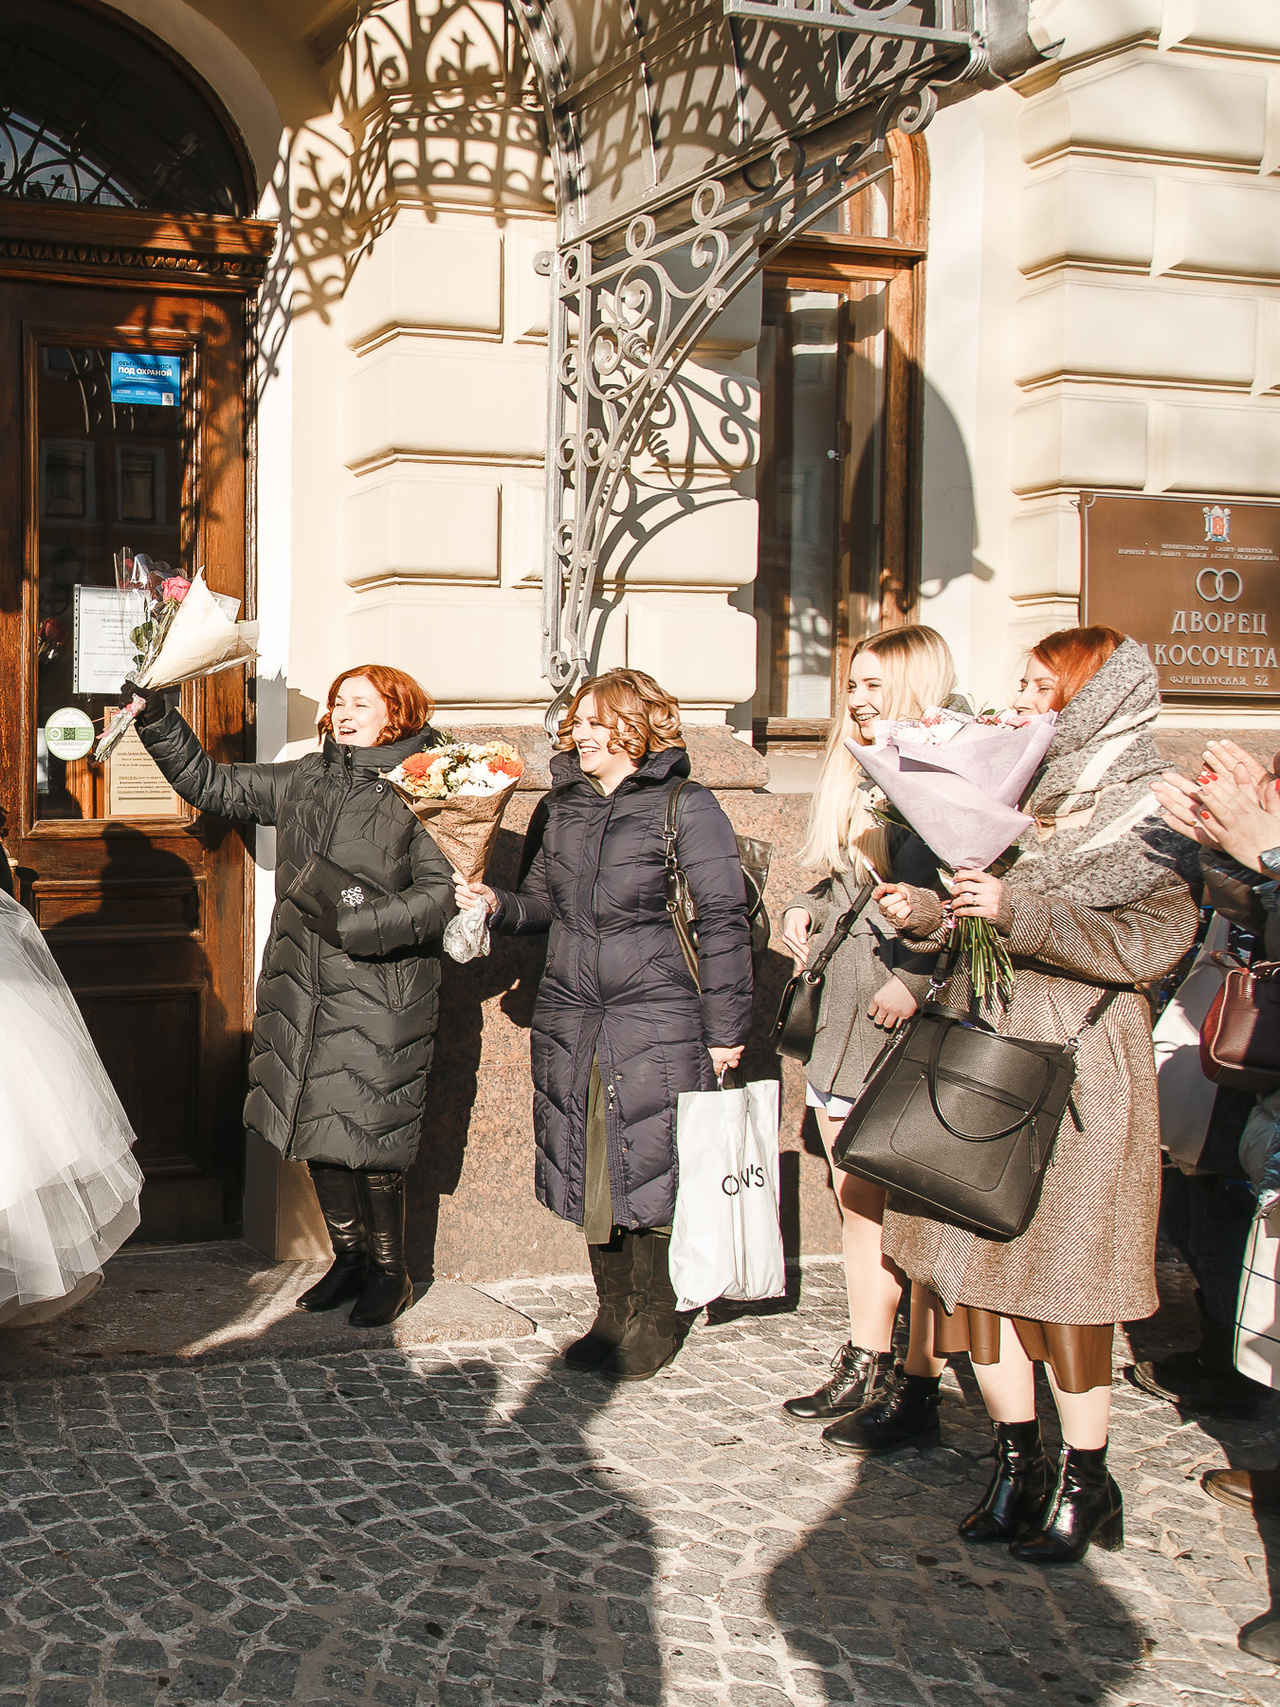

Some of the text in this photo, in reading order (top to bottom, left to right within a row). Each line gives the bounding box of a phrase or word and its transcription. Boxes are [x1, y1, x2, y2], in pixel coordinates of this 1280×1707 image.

[118, 367, 172, 377] ПОД ОХРАНОЙ
[1170, 610, 1268, 637] ДВОРЕЦ
[1254, 674, 1269, 686] 52
